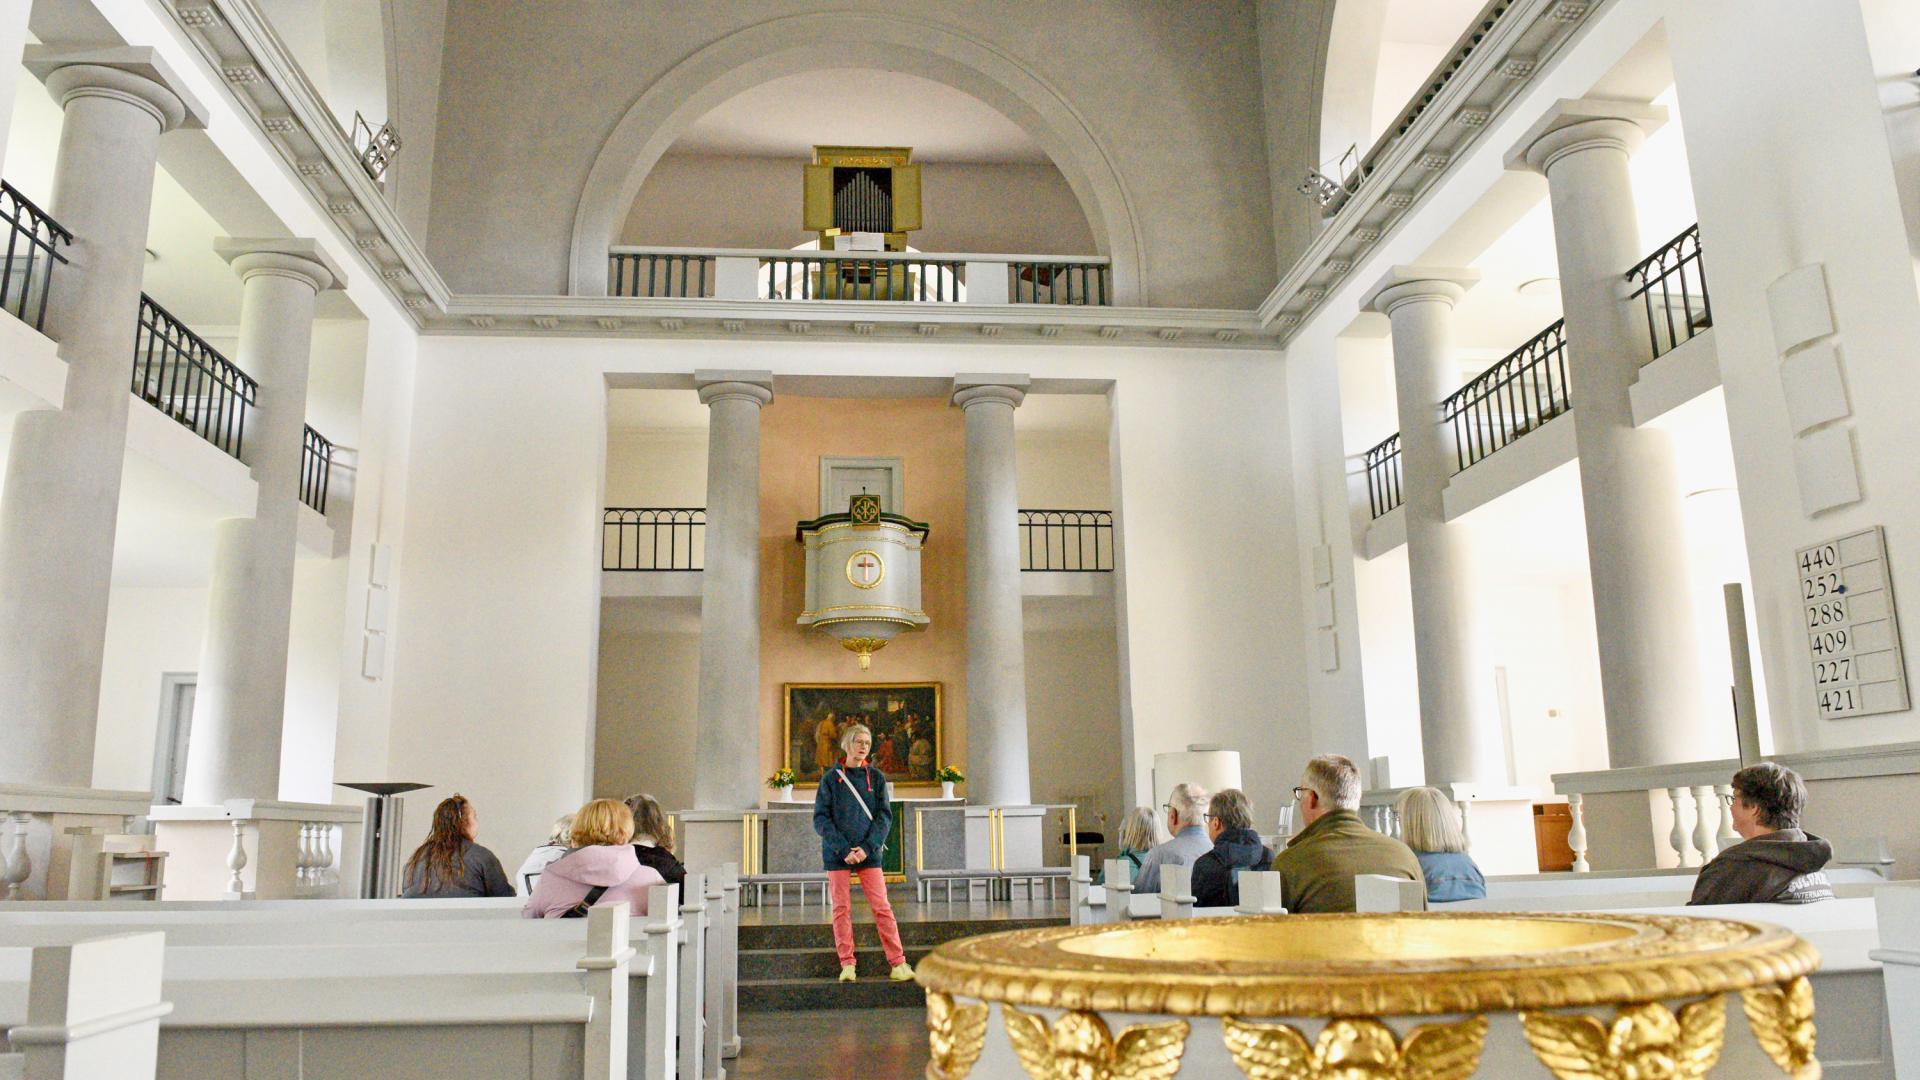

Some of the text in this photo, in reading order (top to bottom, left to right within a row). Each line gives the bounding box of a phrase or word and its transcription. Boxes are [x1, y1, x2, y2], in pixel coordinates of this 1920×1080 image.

[1802, 545, 1835, 572] 440
[1804, 573, 1839, 599] 252
[1808, 601, 1844, 627] 288
[1813, 630, 1847, 655] 409
[1816, 658, 1850, 684] 227
[1821, 689, 1855, 712] 421
